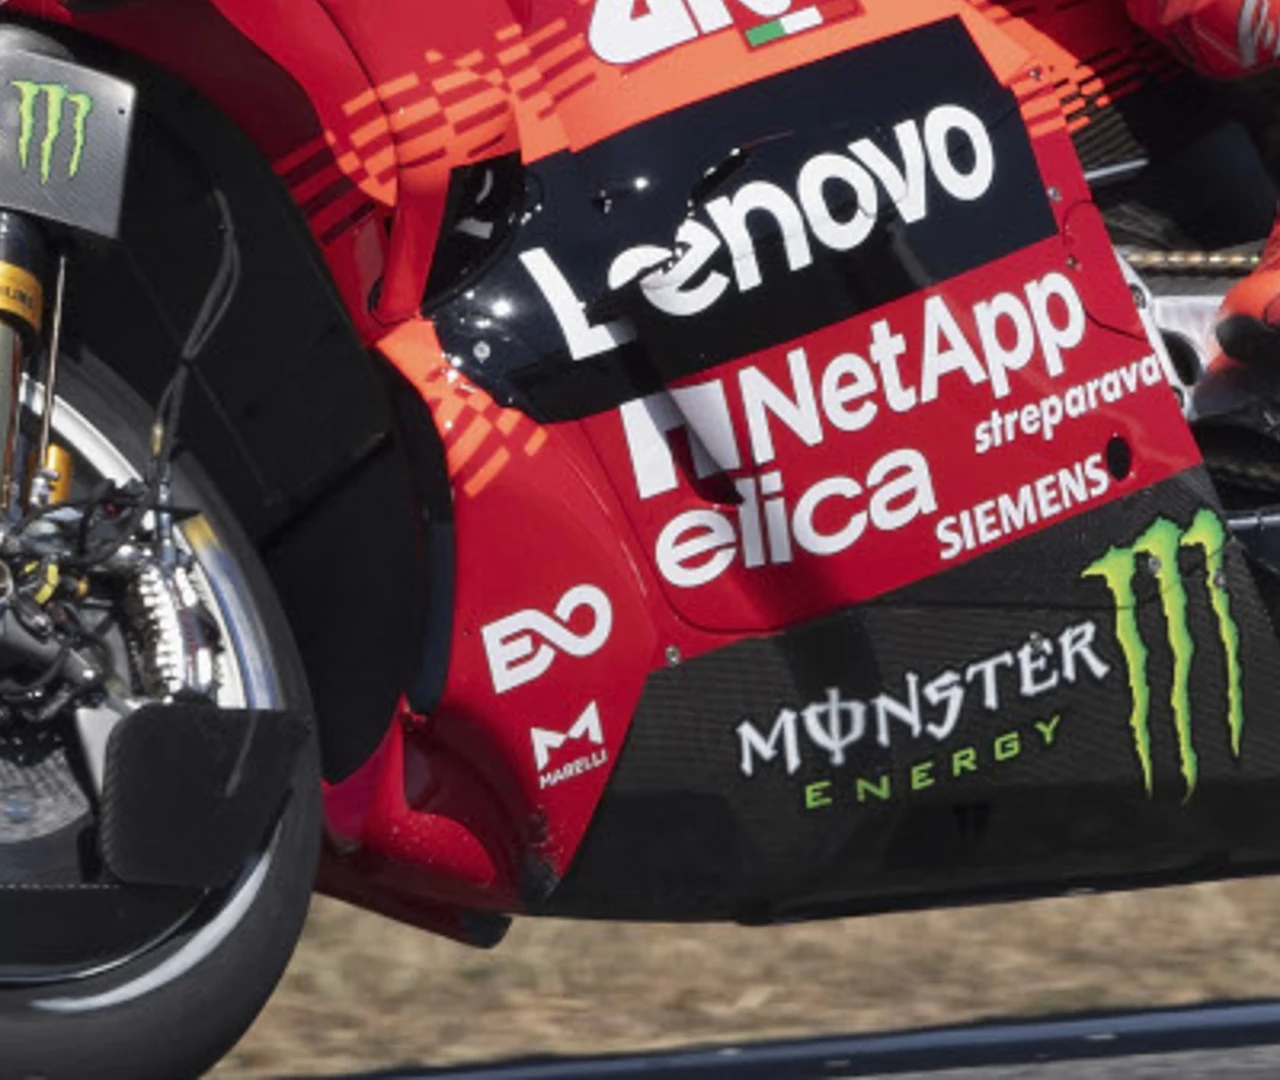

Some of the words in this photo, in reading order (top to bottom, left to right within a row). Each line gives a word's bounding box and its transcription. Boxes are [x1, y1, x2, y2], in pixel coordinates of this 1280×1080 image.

[519, 104, 995, 360] Lenovo
[737, 270, 1086, 468] NetApp
[974, 353, 1164, 454] streparava
[655, 446, 938, 590] elica
[935, 452, 1110, 561] SIEMENS
[736, 620, 1111, 776] MONSTER
[538, 747, 609, 790] MARELLI
[804, 714, 1060, 809] ENERGY
